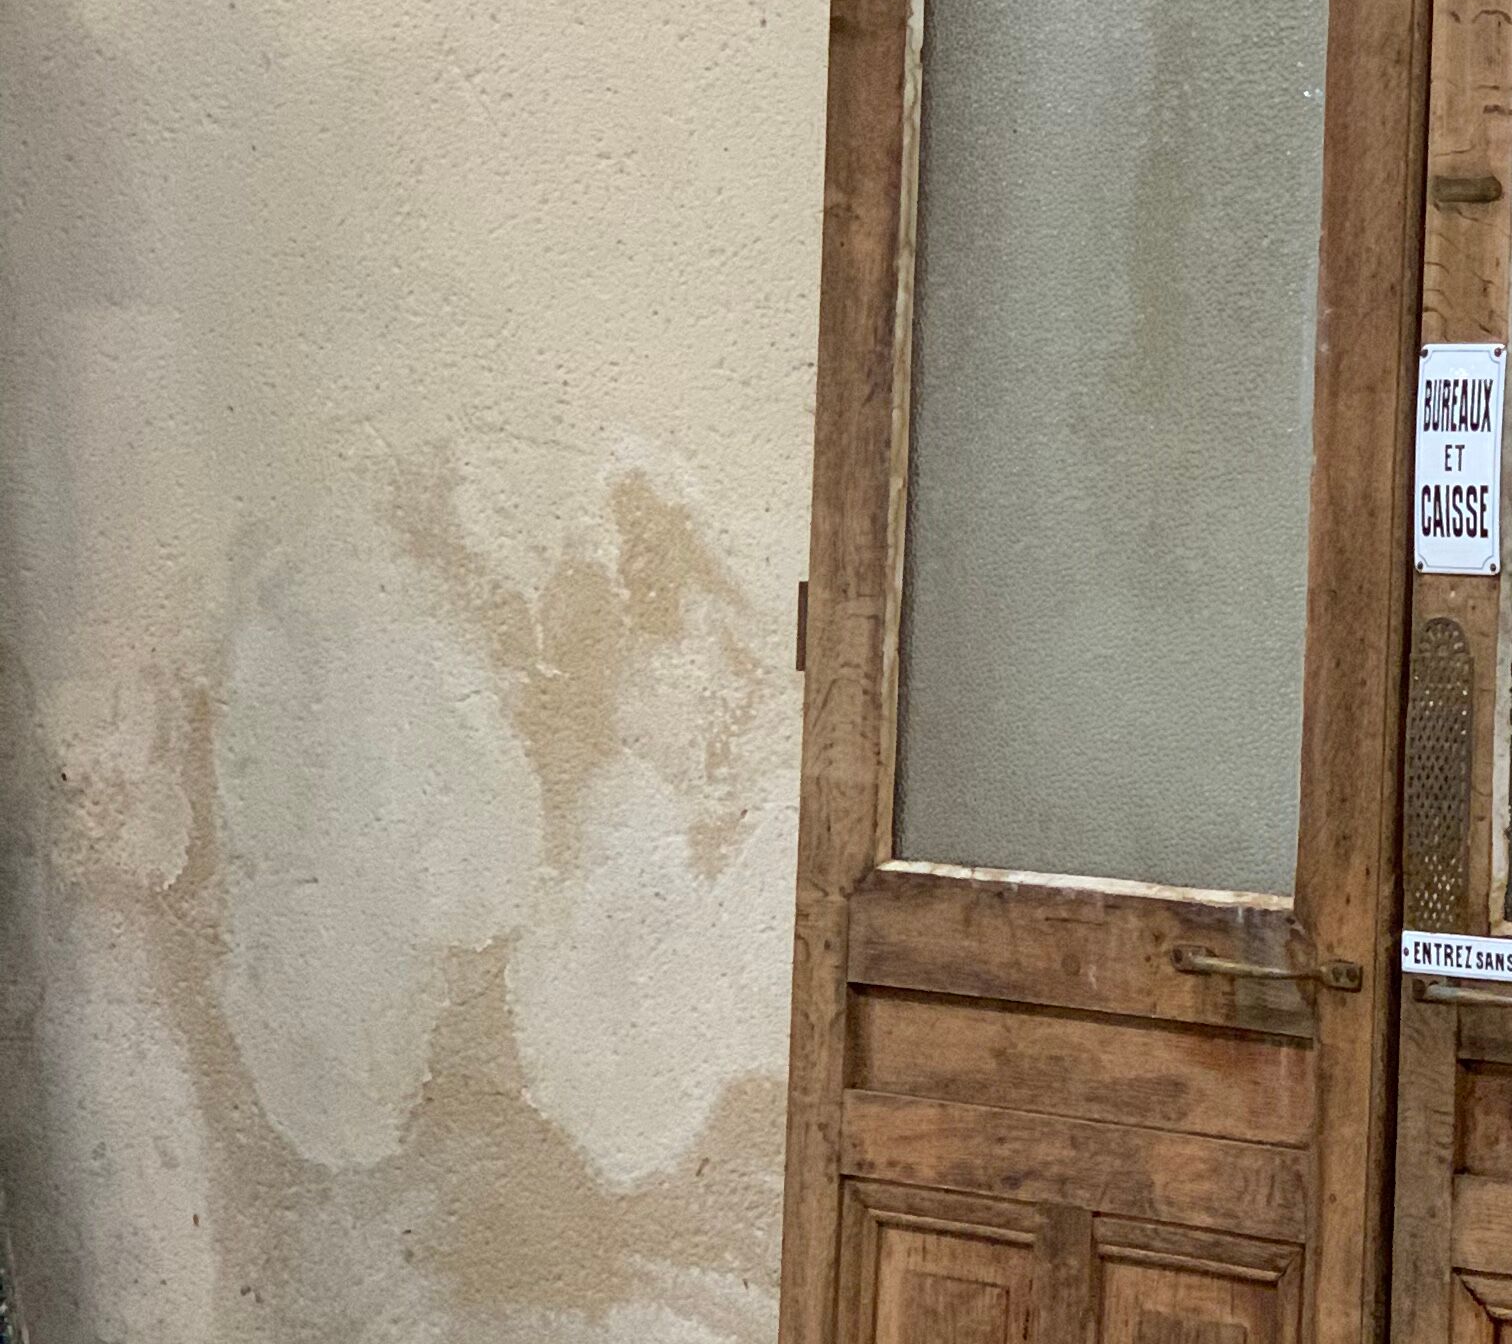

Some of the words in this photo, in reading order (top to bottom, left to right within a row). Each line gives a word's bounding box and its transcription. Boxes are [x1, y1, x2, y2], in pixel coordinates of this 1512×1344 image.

[1423, 379, 1493, 432] BUREAUX
[1444, 444, 1465, 472] ET
[1421, 484, 1489, 538] CAISSE
[1413, 941, 1472, 969] ENTREZ
